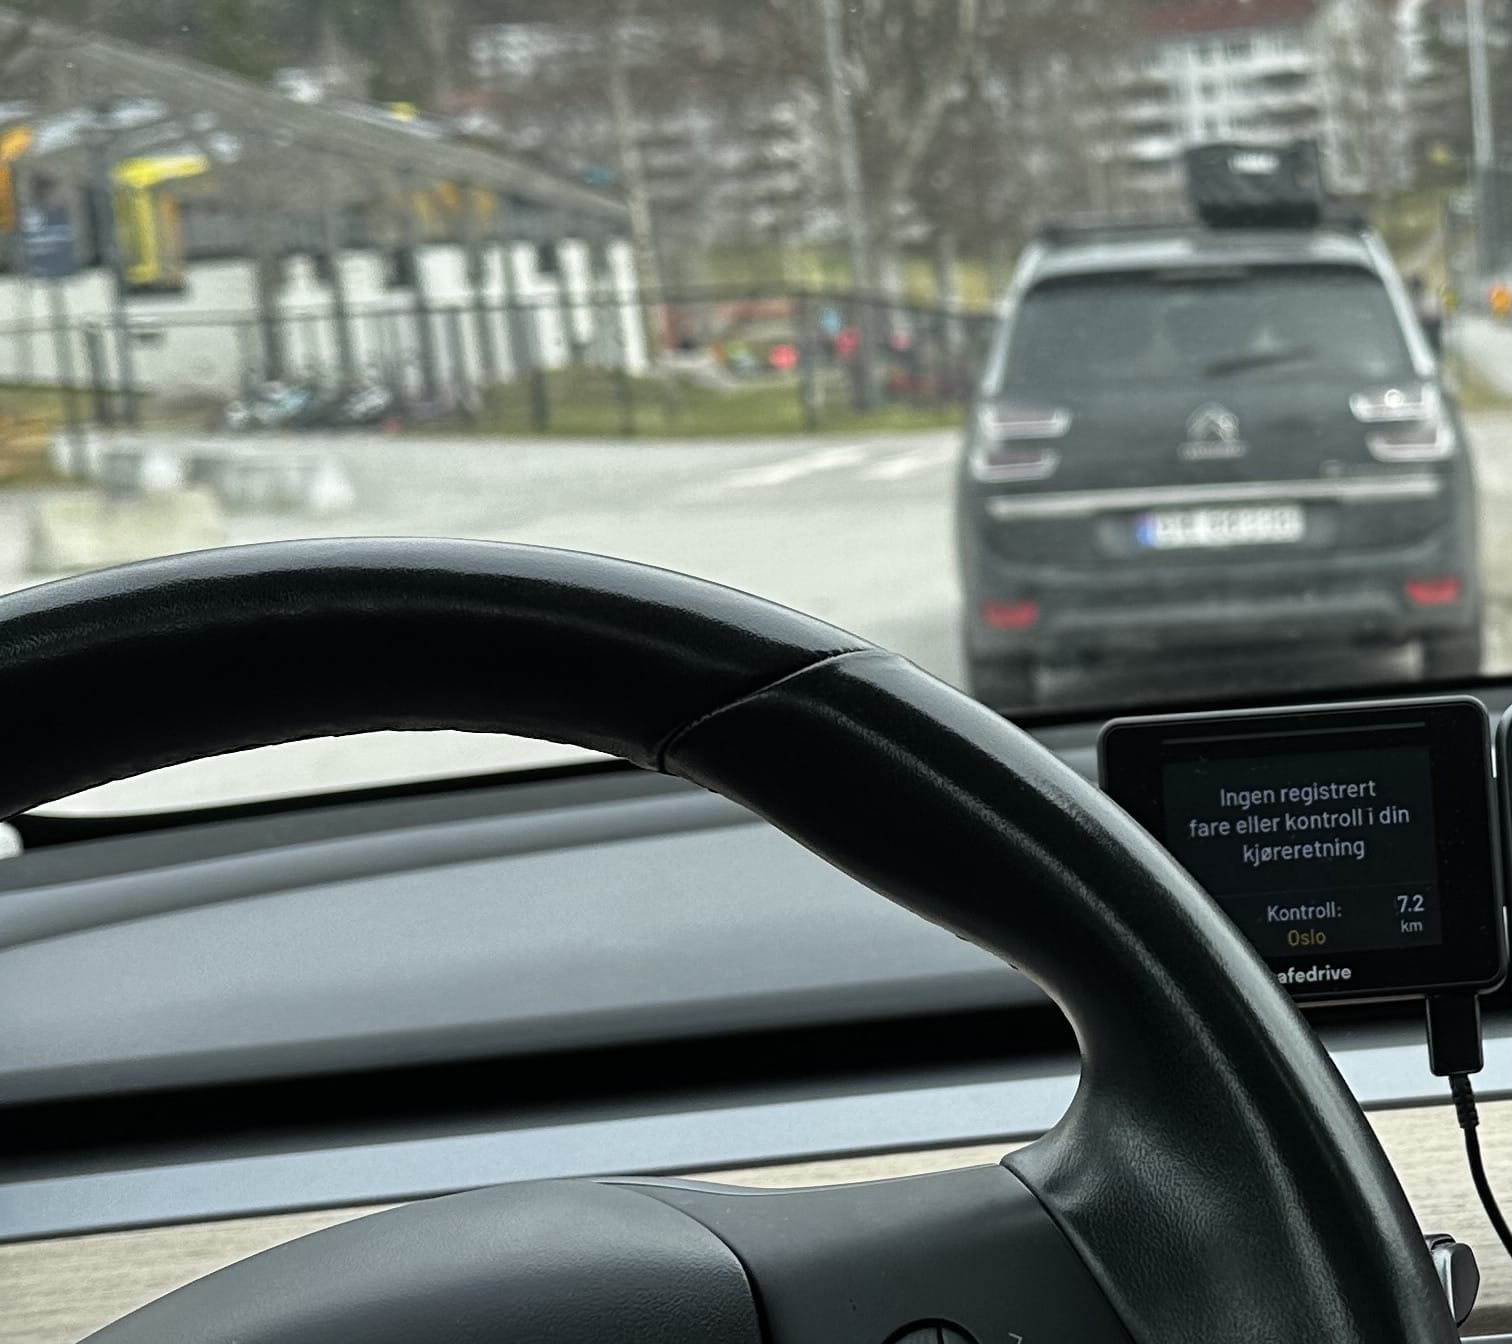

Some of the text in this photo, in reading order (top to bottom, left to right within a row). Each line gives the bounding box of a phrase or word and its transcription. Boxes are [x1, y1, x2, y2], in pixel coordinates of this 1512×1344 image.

[1220, 780, 1376, 811] Ingen registrert
[1189, 818, 1231, 838] fare
[1236, 815, 1280, 834] eller
[1285, 808, 1364, 831] kontroll
[1379, 805, 1410, 825] din
[1243, 839, 1365, 867] kjøreretning
[1266, 902, 1343, 923] Kontroll:
[1397, 894, 1425, 913] 7.2
[1400, 918, 1423, 933] km
[1287, 929, 1327, 947] Oslo
[1277, 964, 1352, 985] afedrive
